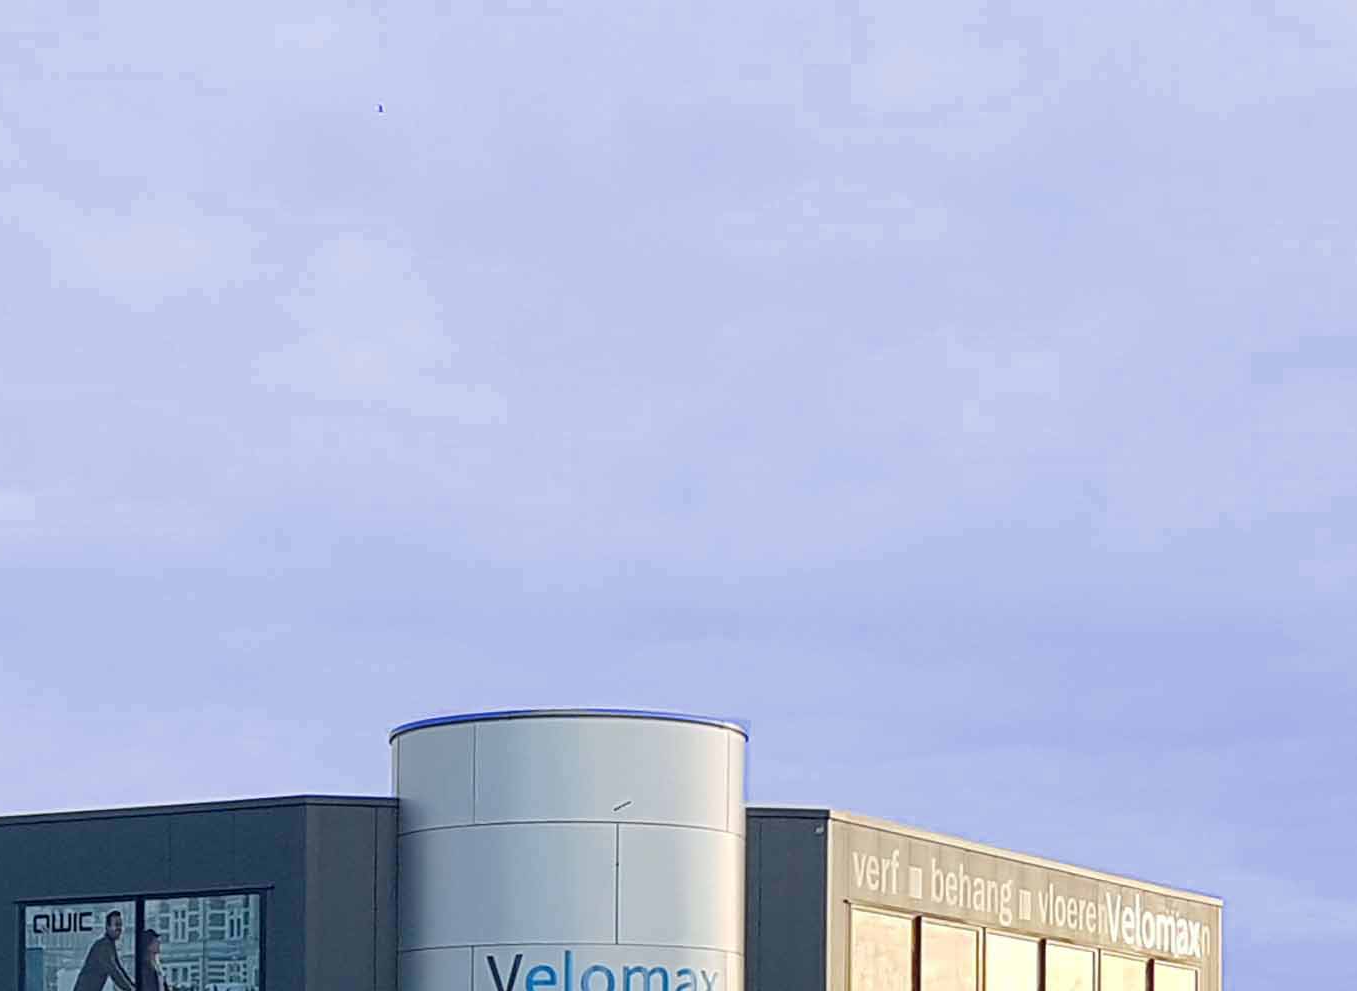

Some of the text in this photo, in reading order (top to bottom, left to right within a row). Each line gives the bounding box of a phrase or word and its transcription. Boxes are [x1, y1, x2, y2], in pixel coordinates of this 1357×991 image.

[852, 850, 900, 895] verf
[931, 857, 1014, 927] behang
[33, 912, 93, 933] QWIC
[1106, 892, 1203, 958] Velomax
